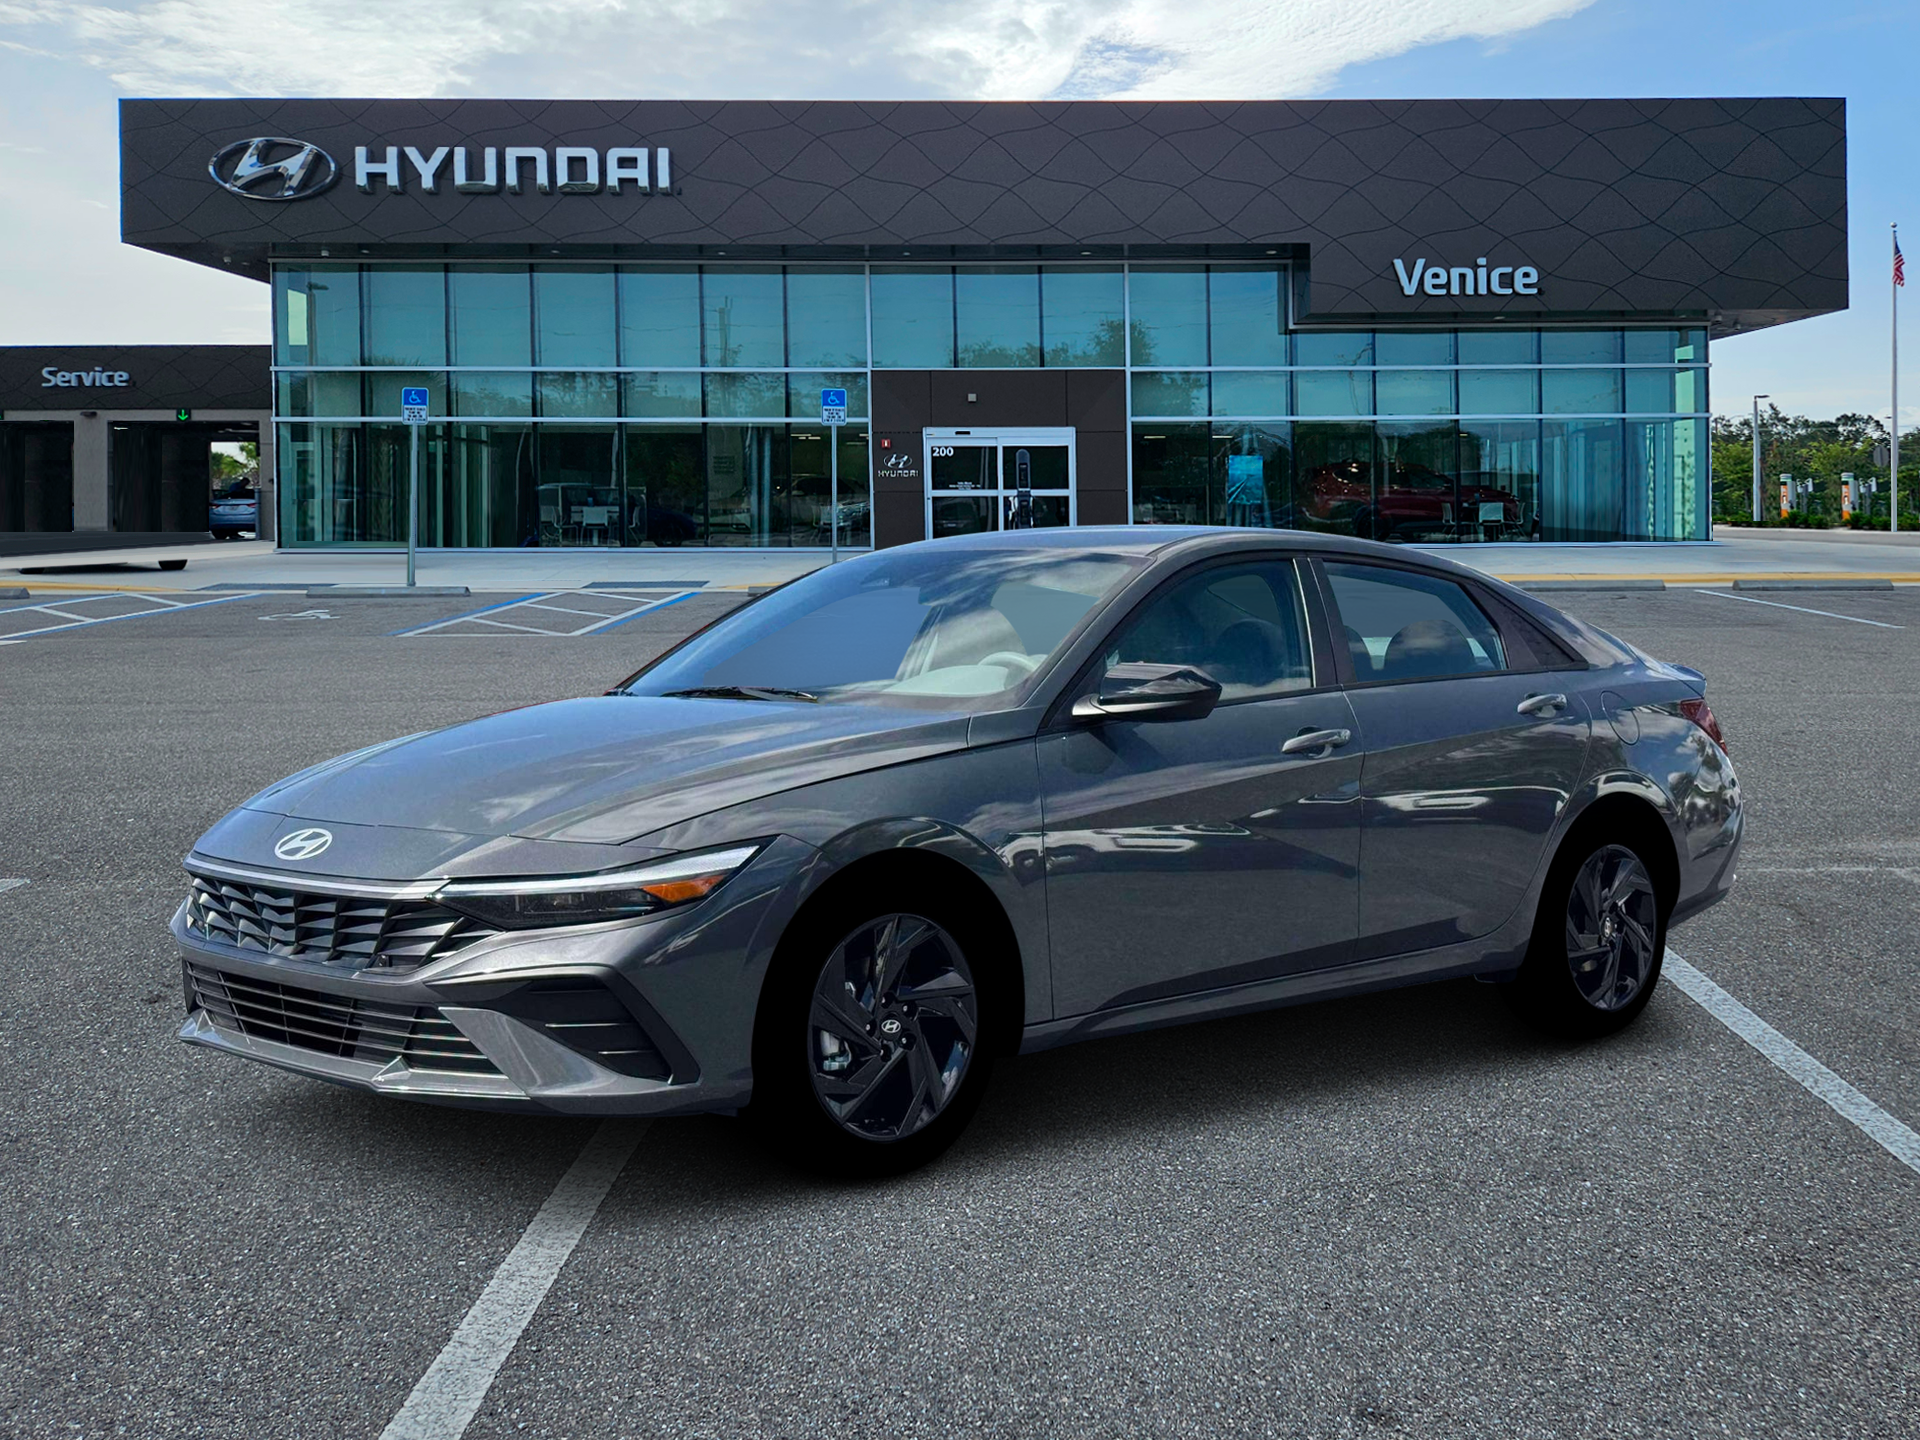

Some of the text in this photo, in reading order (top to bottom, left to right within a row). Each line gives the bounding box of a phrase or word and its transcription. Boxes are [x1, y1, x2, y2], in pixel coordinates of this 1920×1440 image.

[354, 146, 671, 195] HYUNDAI
[1393, 257, 1538, 295] Venice
[41, 366, 130, 387] Service
[932, 447, 954, 457] 200
